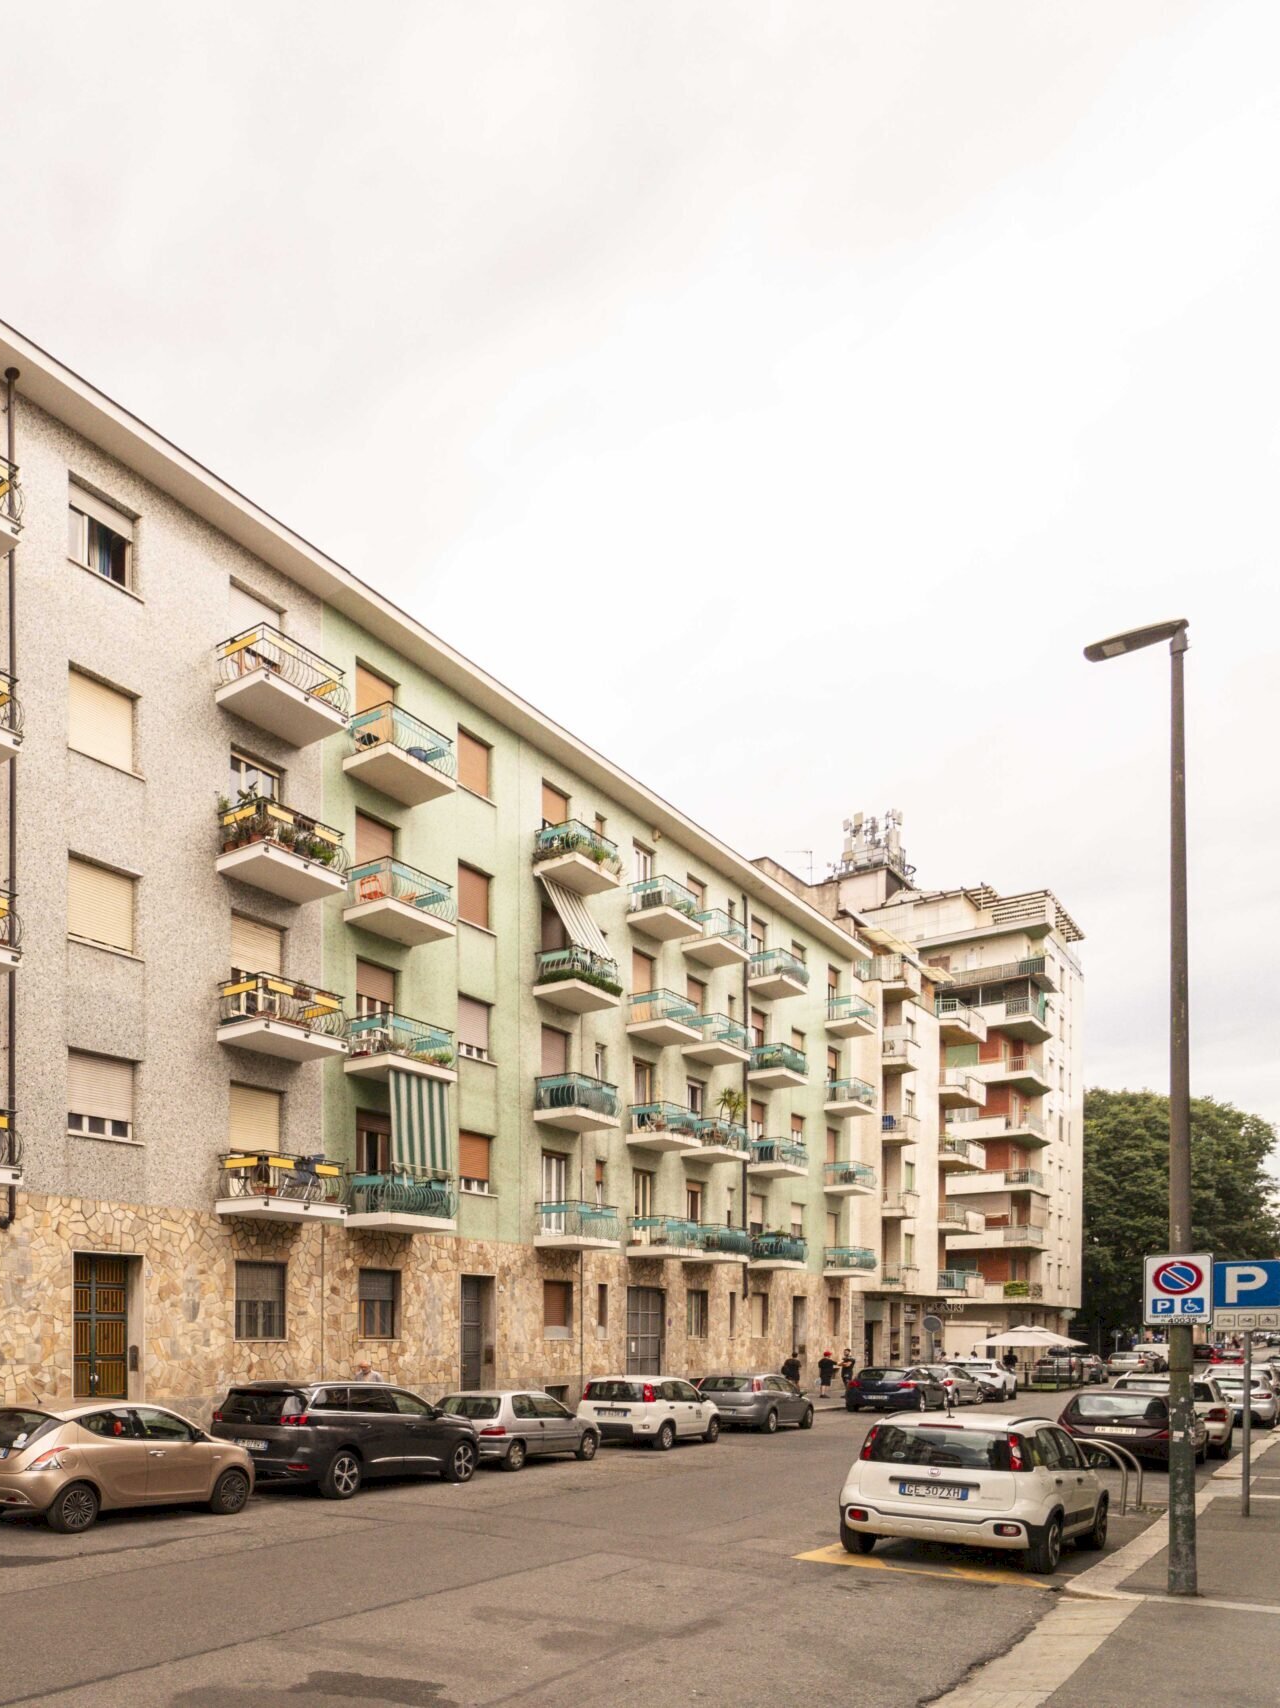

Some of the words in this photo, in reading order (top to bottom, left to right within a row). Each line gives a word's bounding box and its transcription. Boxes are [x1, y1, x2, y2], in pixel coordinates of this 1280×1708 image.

[1225, 1266, 1268, 1304] P
[1157, 1300, 1171, 1313] P
[925, 1486, 960, 1498] 307XH
